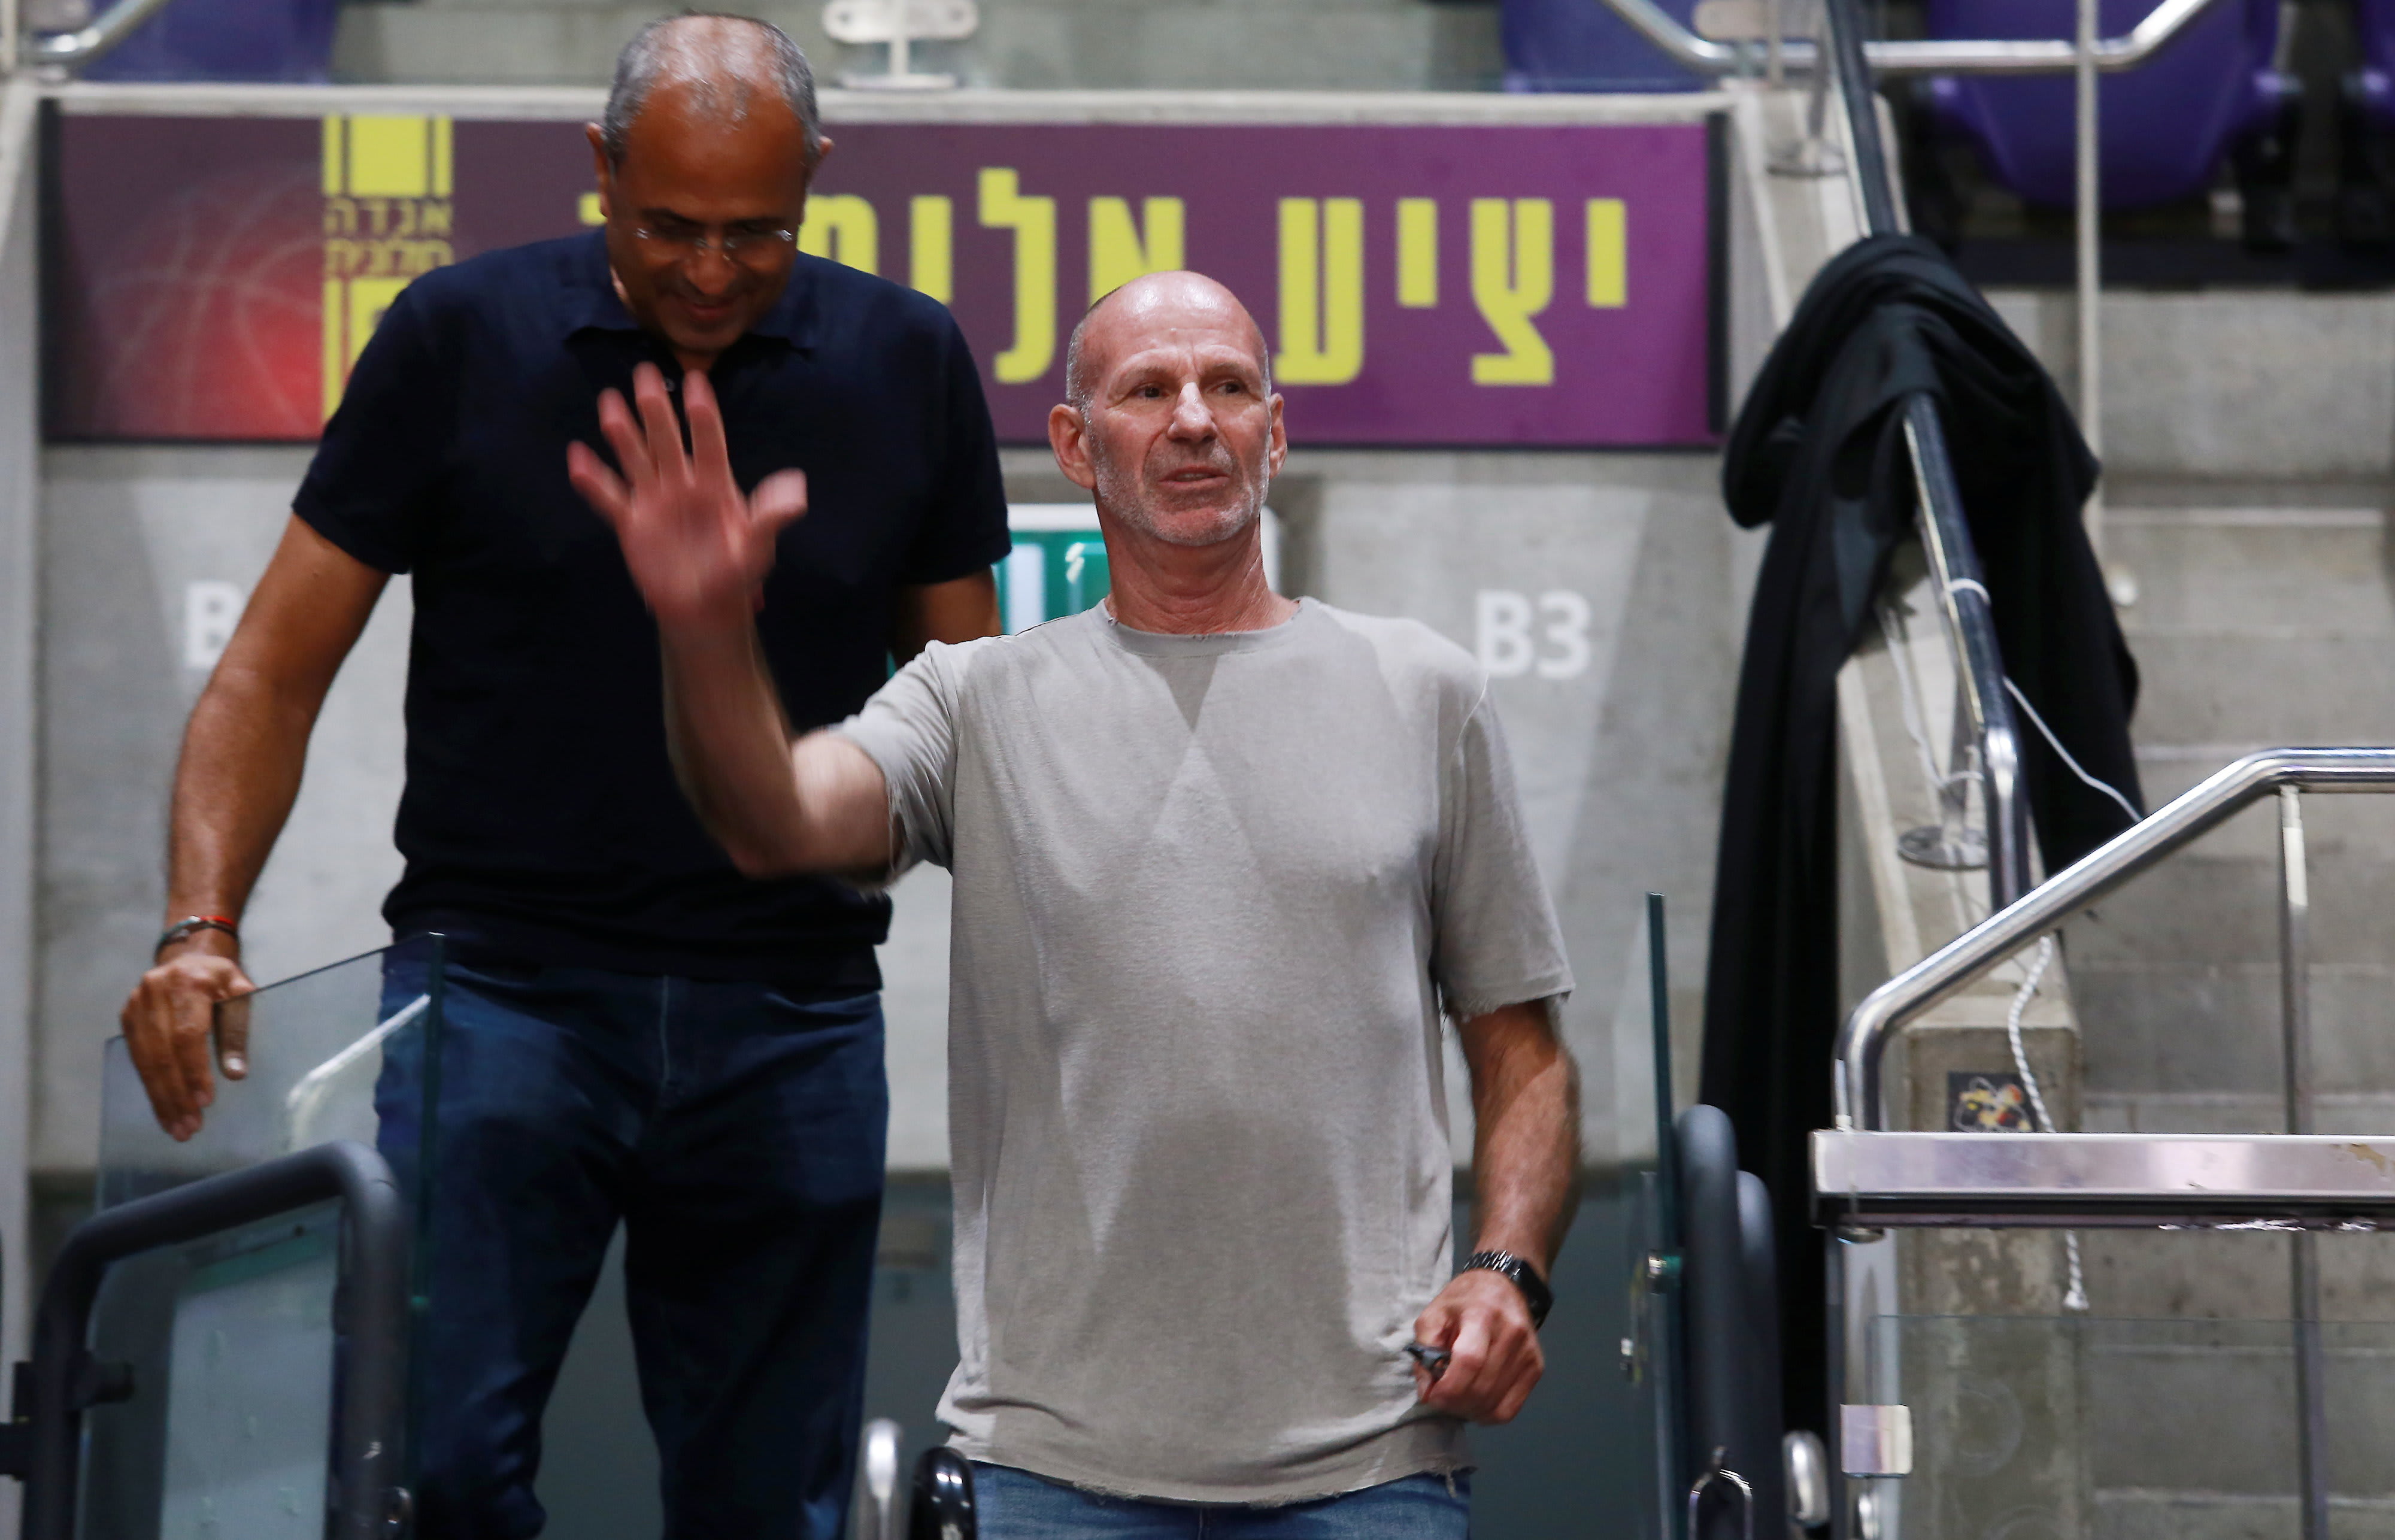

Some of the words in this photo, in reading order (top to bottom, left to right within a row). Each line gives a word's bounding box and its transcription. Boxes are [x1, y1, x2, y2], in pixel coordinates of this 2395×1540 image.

[1274, 198, 1627, 384] יציע
[184, 580, 245, 669] B
[1476, 589, 1591, 679] B3
